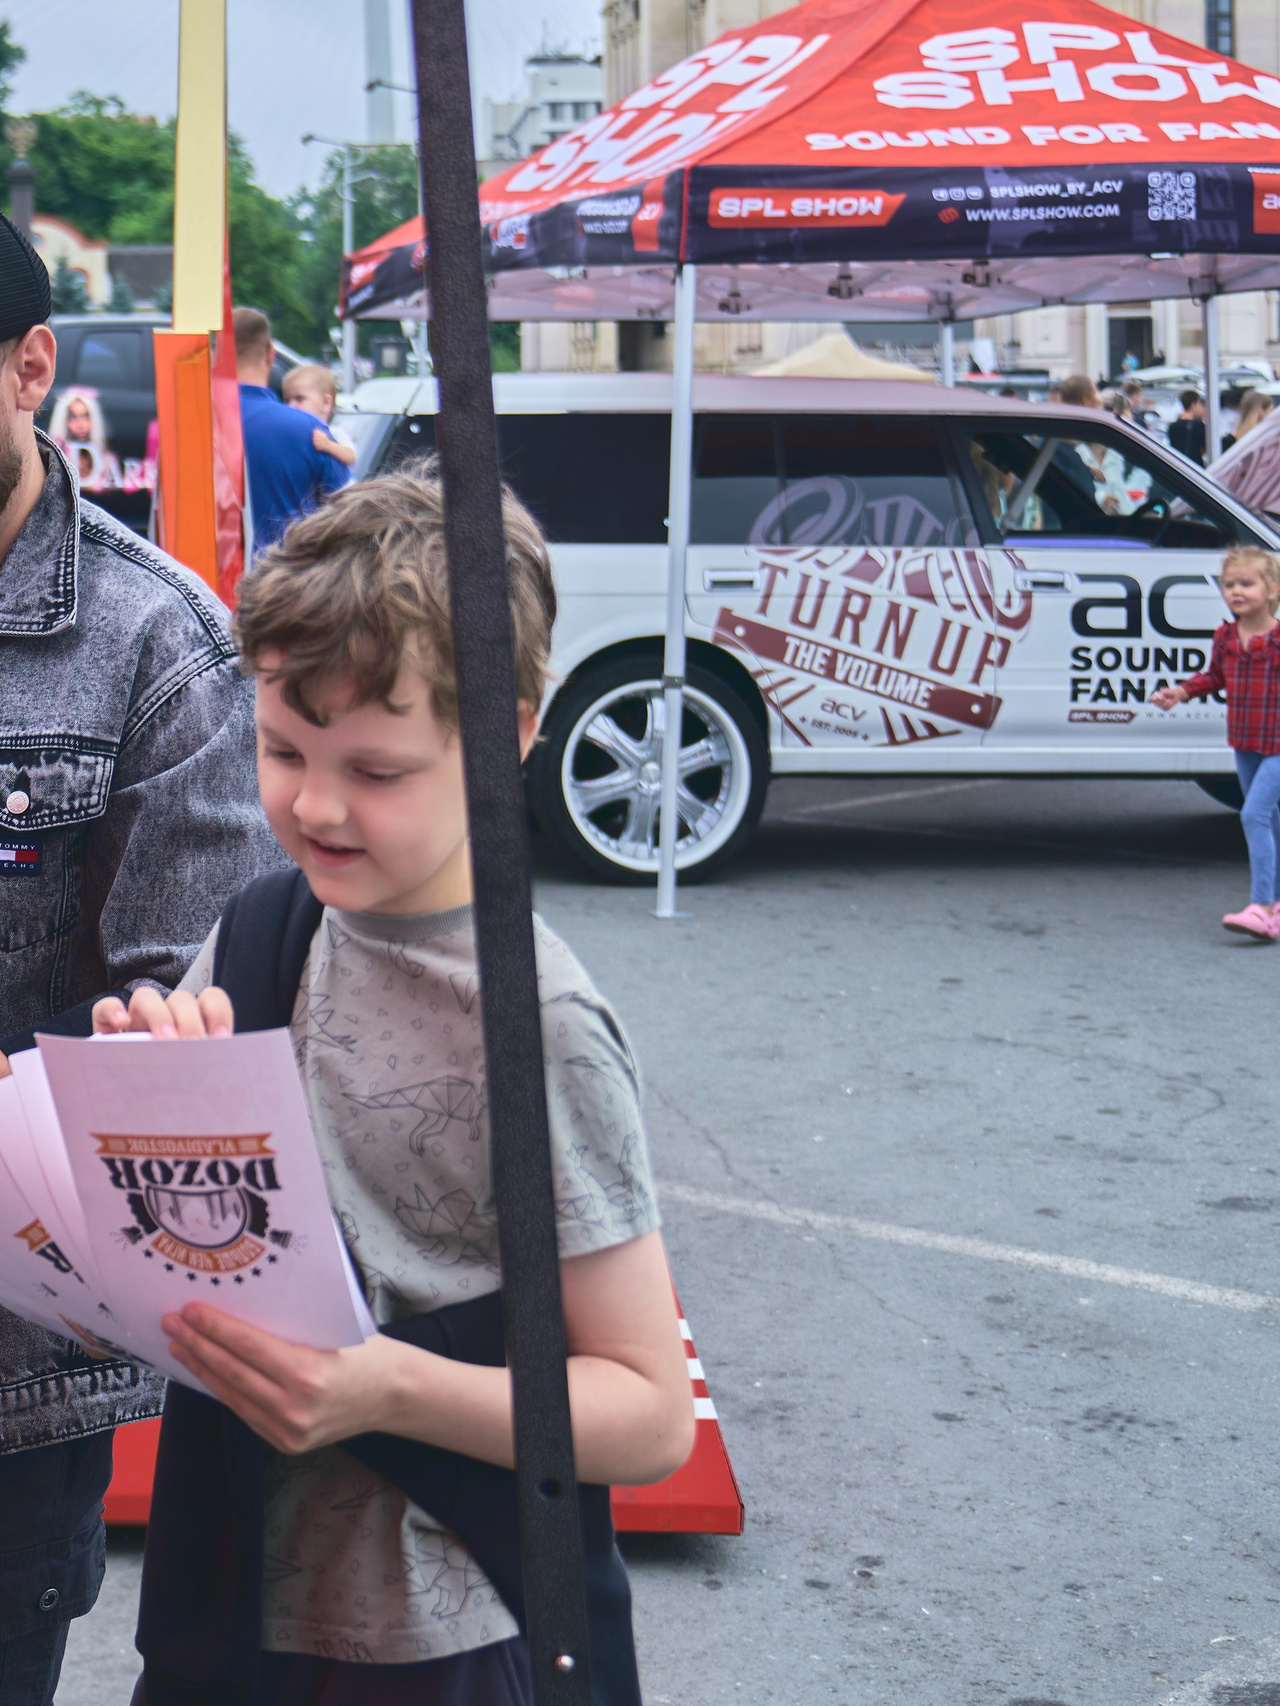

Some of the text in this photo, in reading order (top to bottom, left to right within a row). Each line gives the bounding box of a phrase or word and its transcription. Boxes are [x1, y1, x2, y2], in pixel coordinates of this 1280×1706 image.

[920, 21, 1229, 76] SPL
[621, 33, 832, 113] SPL
[804, 125, 1012, 151] SOUND
[1019, 122, 1150, 146] FOR
[989, 179, 1124, 199] SPLSHOW_BY_ACV
[717, 196, 883, 218] SPL SHOW
[965, 203, 1121, 222] WWW.SPLSHOW.COM
[754, 560, 1012, 687] TURN UP
[782, 635, 937, 710] THE VOLUME
[1070, 646, 1206, 672] SOUND
[820, 698, 867, 722] acv
[127, 1138, 237, 1153] VLADIVOSTOK
[99, 1156, 282, 1191] DOZOR
